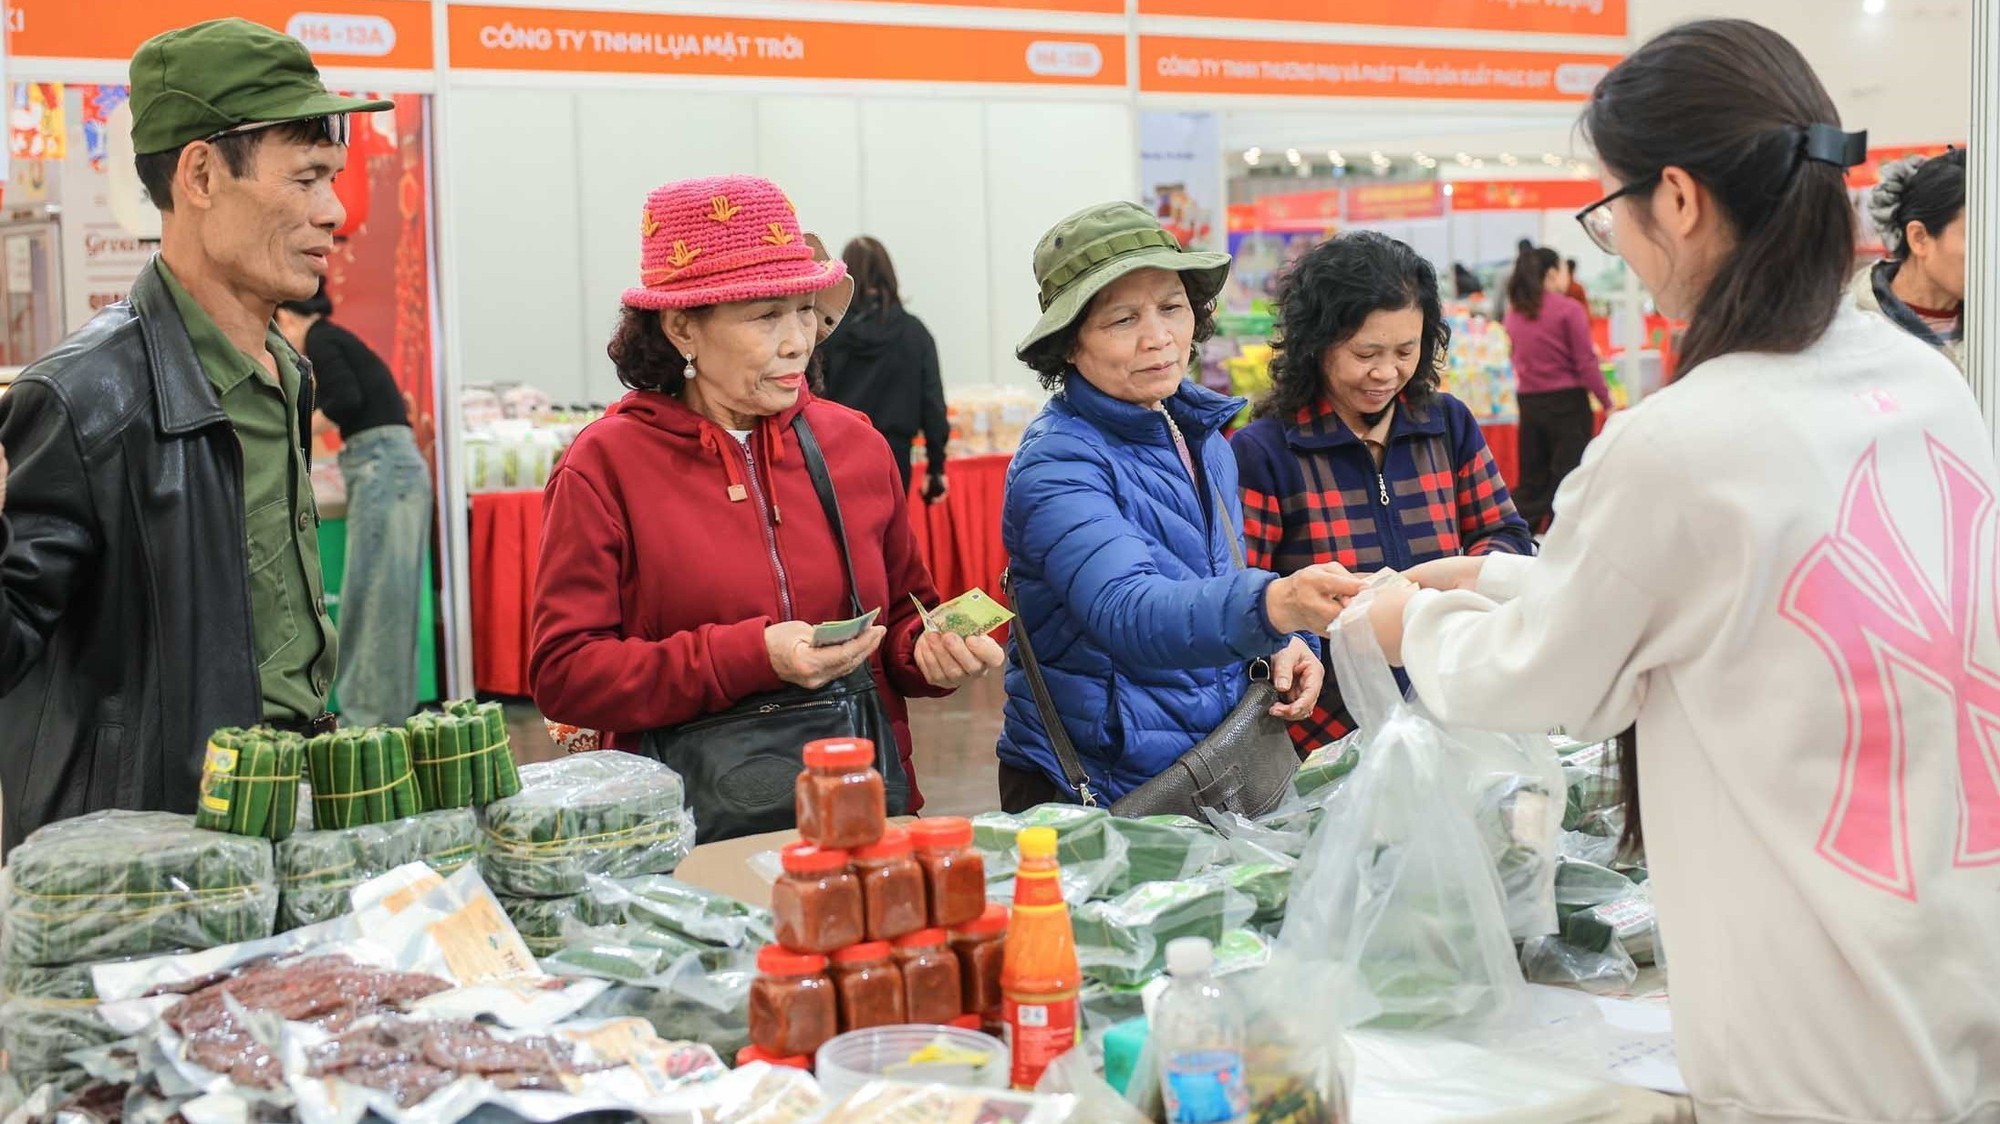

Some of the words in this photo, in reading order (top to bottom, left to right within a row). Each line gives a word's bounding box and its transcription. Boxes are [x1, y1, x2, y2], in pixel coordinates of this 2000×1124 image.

[480, 22, 552, 50] CÔNG
[556, 29, 586, 51] TY
[591, 30, 652, 53] TNHH
[654, 34, 700, 59] LỤA
[702, 32, 750, 61] MẶT
